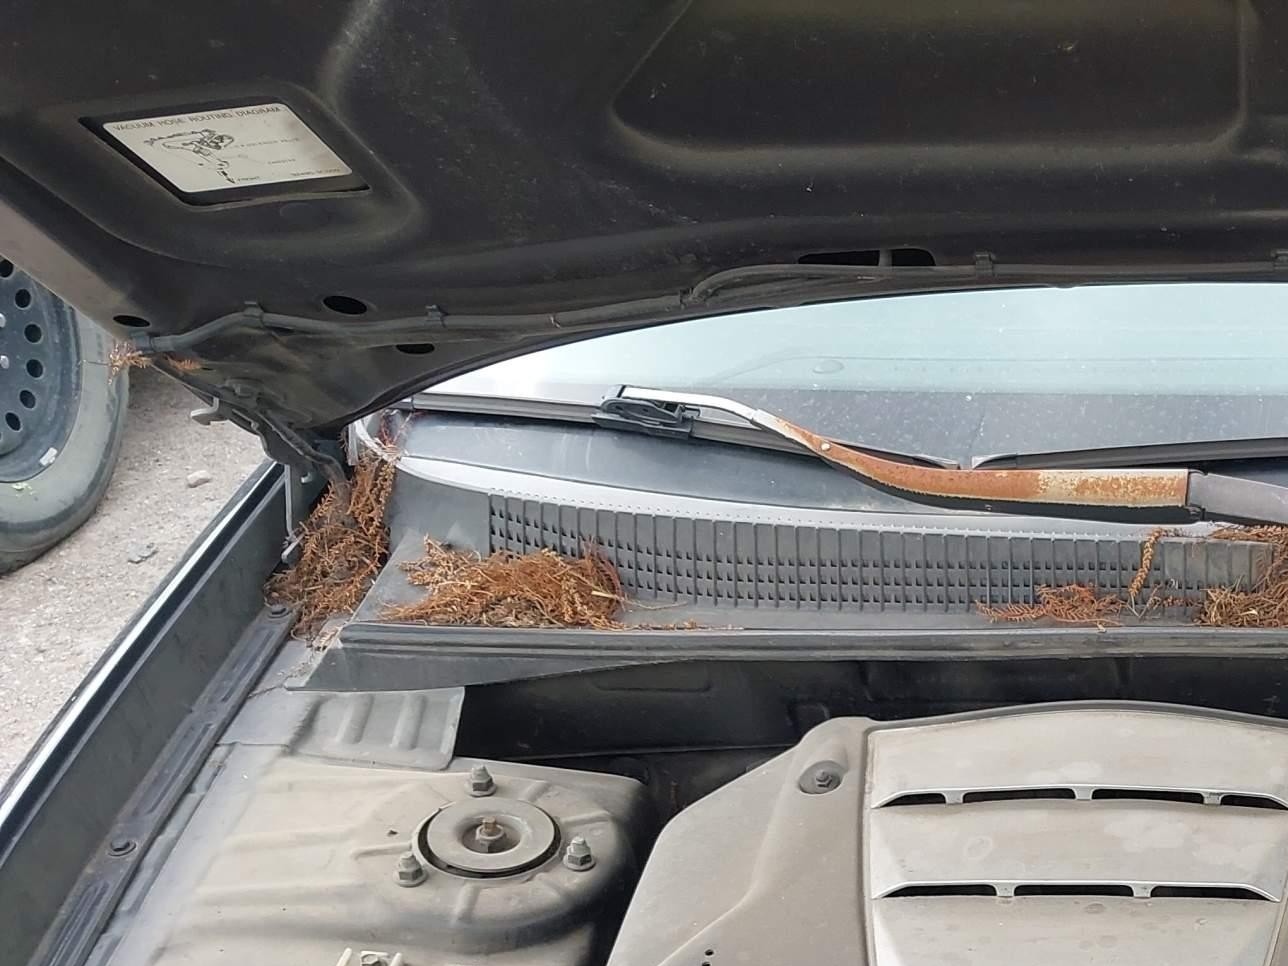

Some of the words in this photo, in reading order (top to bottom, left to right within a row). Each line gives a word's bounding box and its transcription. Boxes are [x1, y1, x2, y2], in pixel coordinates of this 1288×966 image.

[112, 121, 154, 132] VACUUM
[157, 116, 184, 128] HOSE
[189, 112, 233, 123] ROUTING
[235, 106, 281, 119] DIAGRAM
